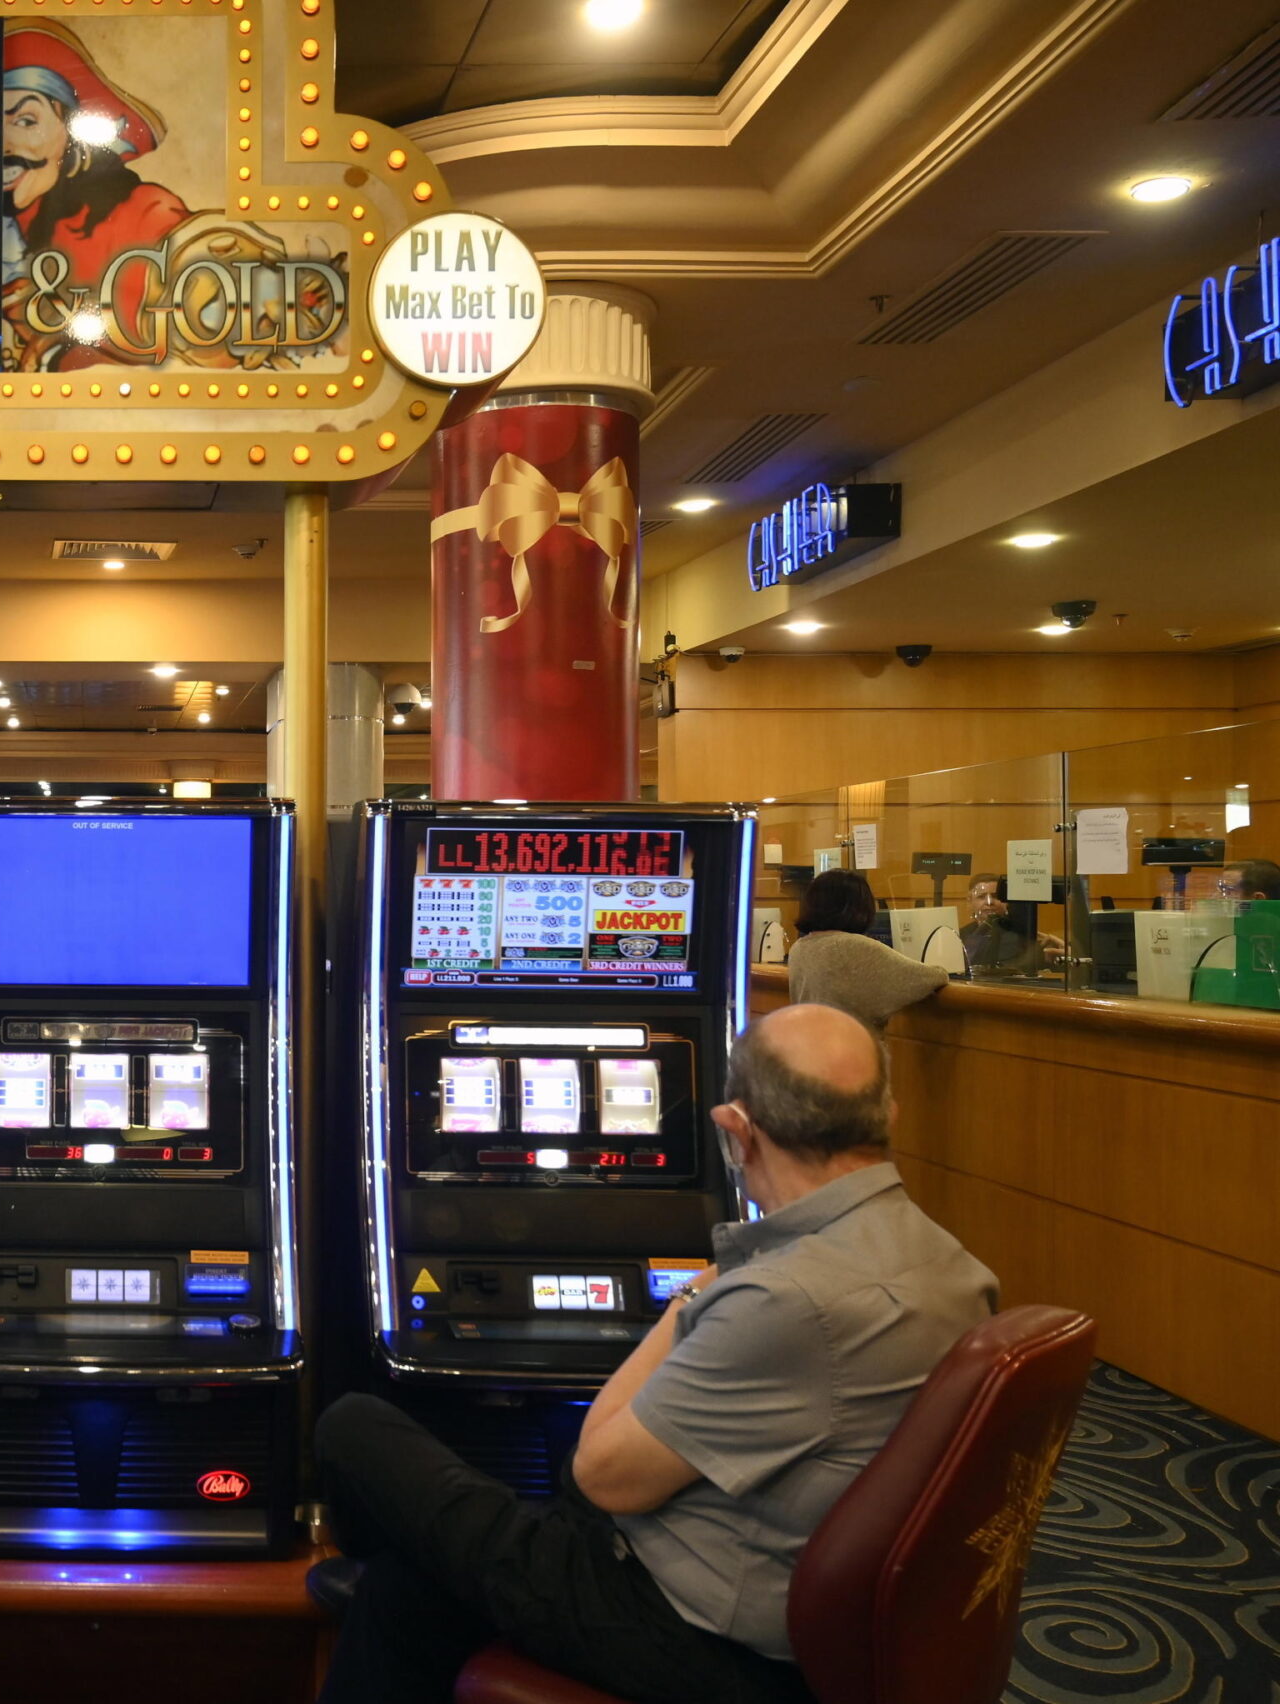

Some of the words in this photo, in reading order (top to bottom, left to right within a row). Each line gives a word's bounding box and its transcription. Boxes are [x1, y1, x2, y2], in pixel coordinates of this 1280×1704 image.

[410, 229, 504, 272] PLAY
[26, 251, 89, 334] &
[99, 241, 346, 366] GOLD
[385, 284, 442, 320] Max
[451, 284, 496, 320] Bet
[505, 284, 535, 320] To
[421, 332, 494, 374] WIN
[747, 482, 832, 592] CASHIER
[535, 896, 583, 911] 500
[596, 912, 683, 930] JACKPOT
[568, 933, 581, 944] 2
[590, 961, 608, 970] 3RD
[609, 961, 642, 970] CREDIT
[644, 961, 684, 970] WINNERS
[67, 1147, 82, 1160] 36
[163, 1147, 170, 1160] 0
[202, 1147, 210, 1160] 3
[600, 1152, 625, 1166] 211
[657, 1152, 664, 1166] 3
[589, 1283, 610, 1304] 7
[203, 1475, 244, 1496] Bally
